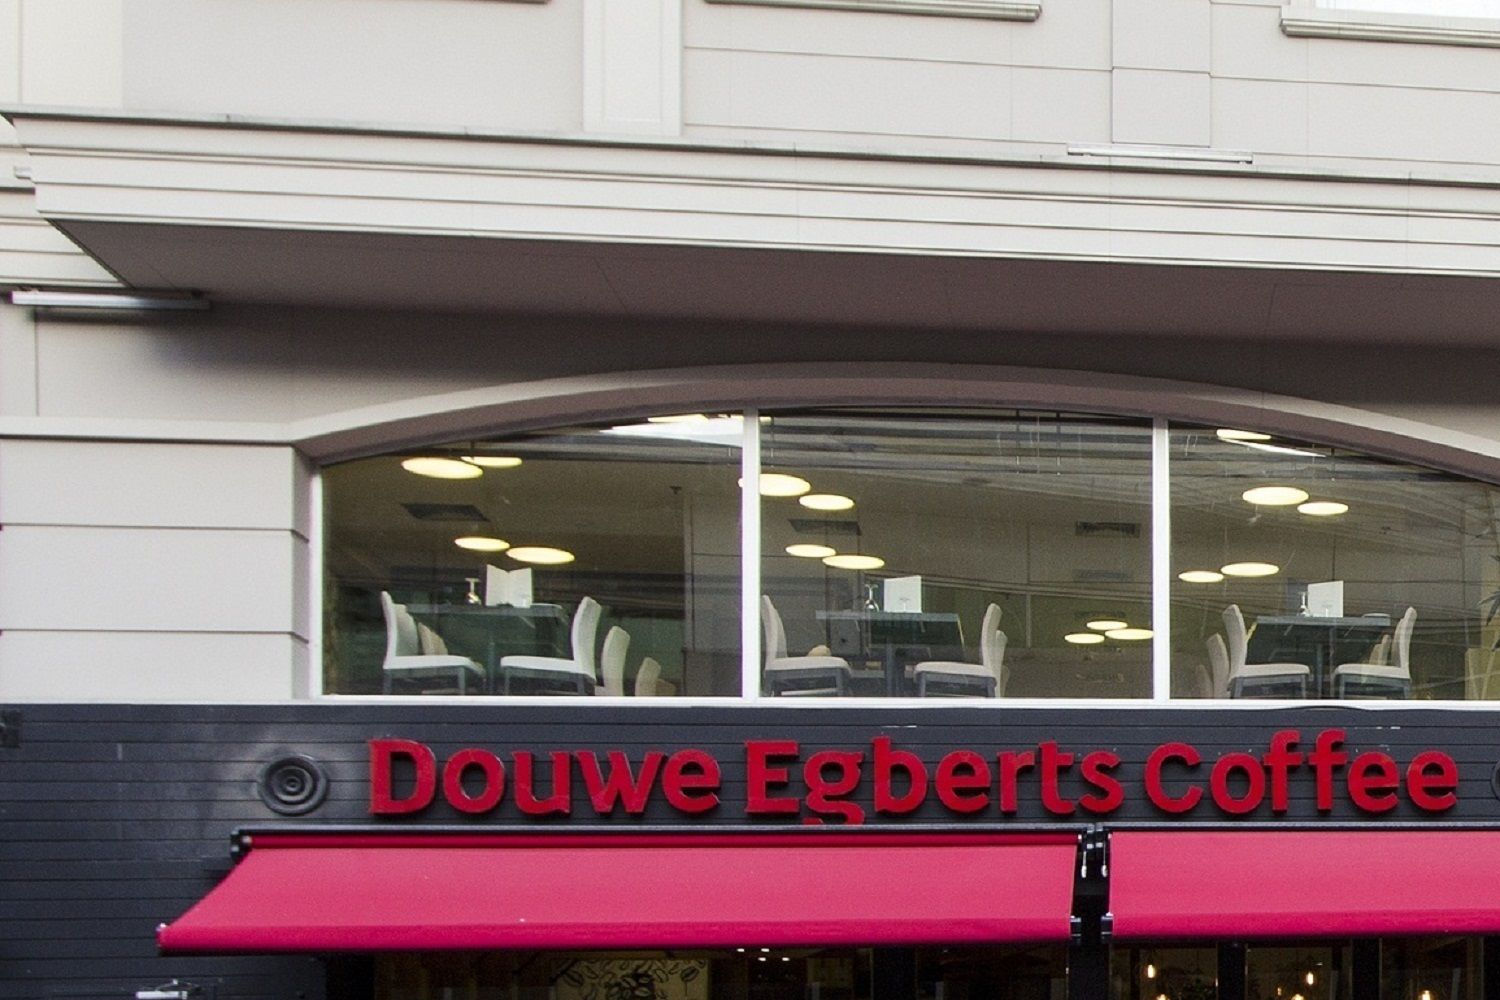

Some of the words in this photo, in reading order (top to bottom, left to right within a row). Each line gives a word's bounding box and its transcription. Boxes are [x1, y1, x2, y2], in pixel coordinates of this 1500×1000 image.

[368, 738, 721, 815] Douwe
[744, 735, 1124, 826] Egberts
[1143, 728, 1460, 815] Coffee
